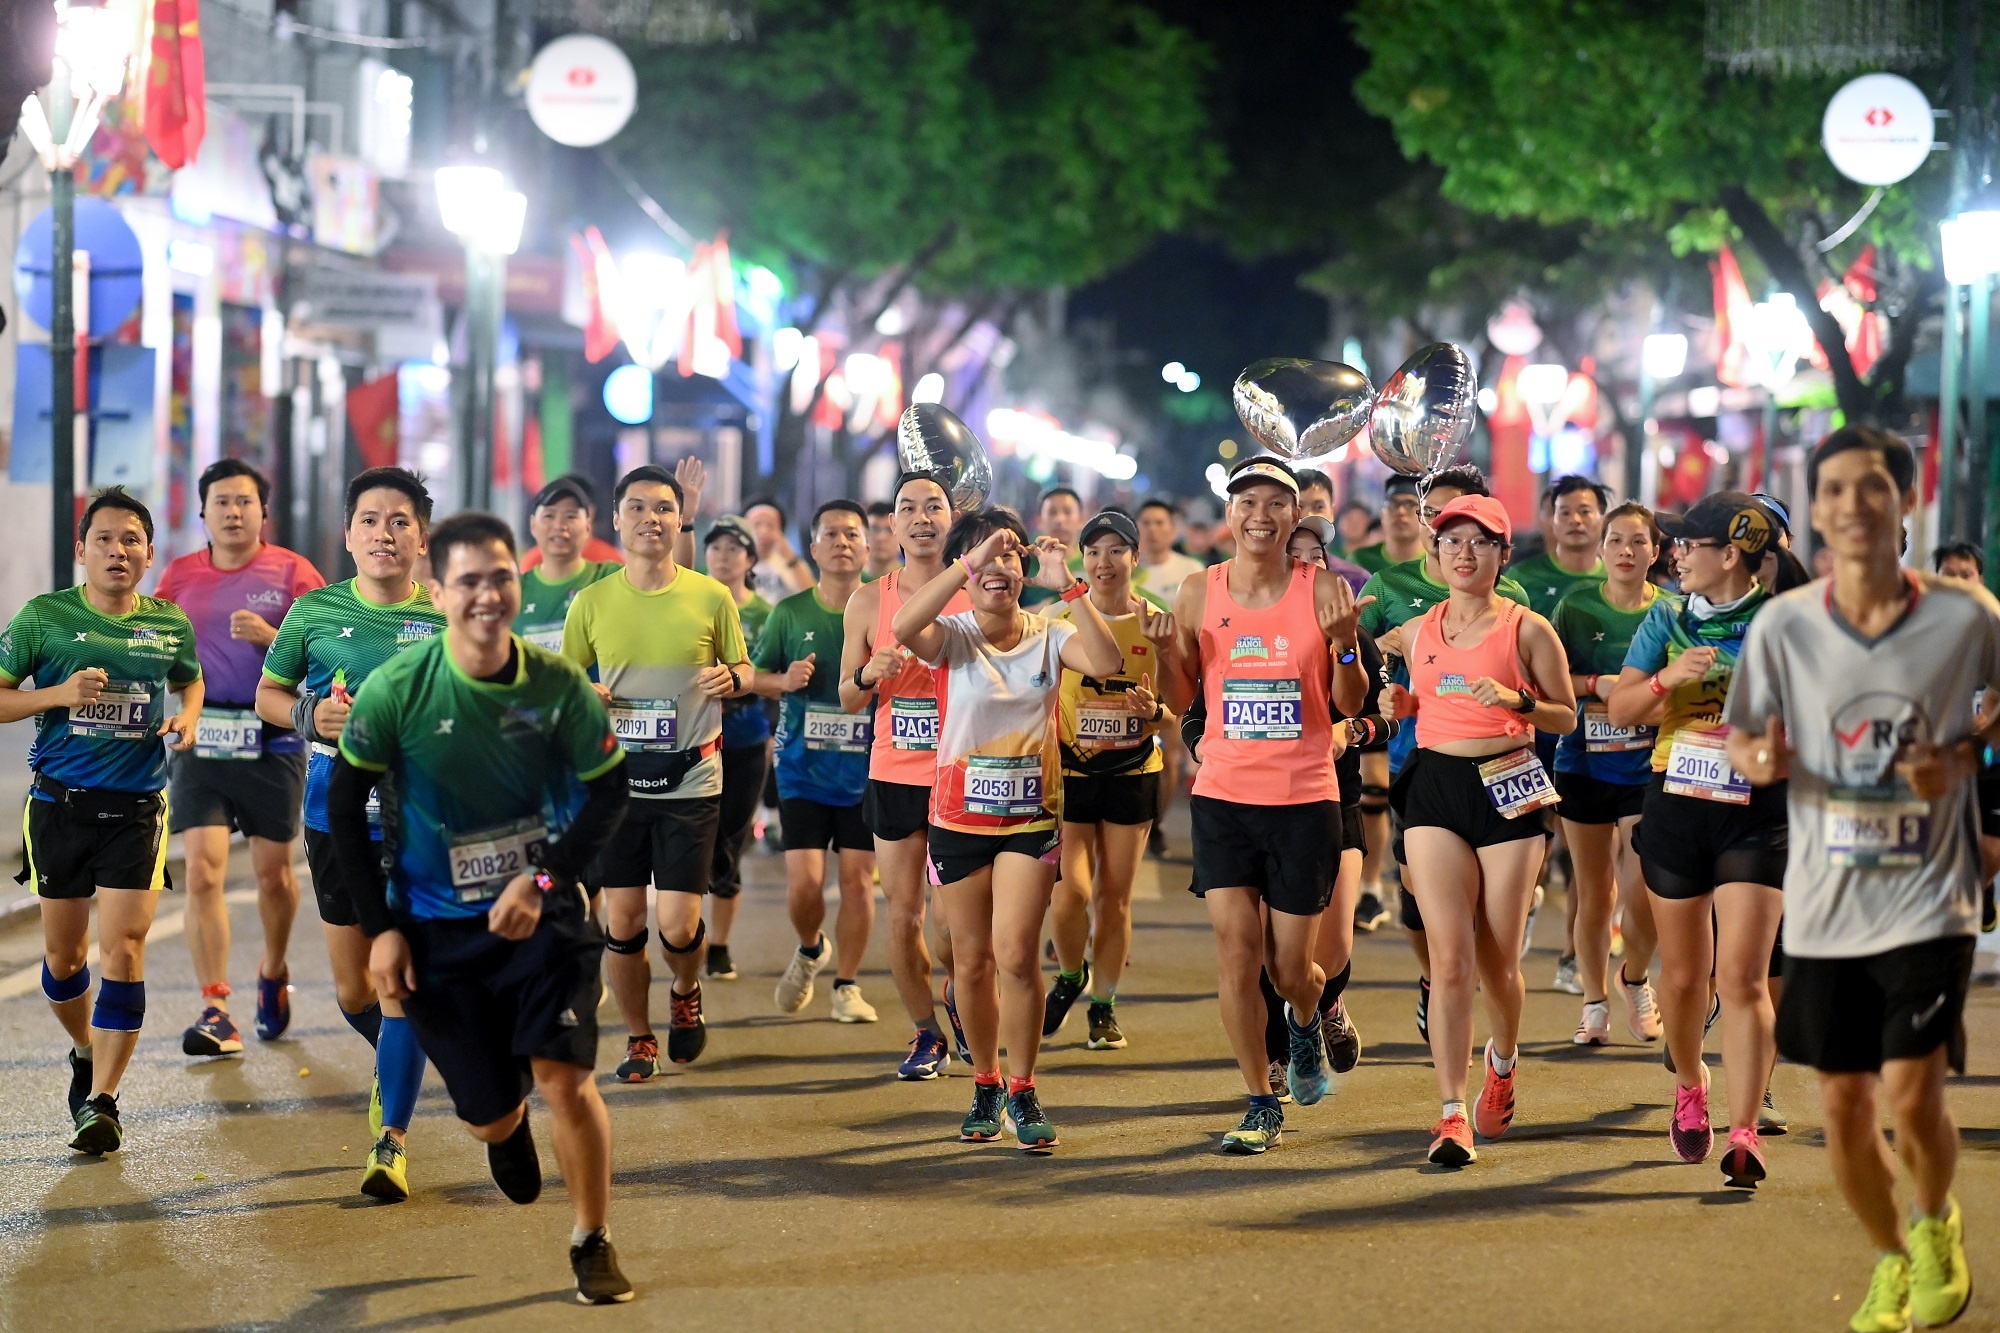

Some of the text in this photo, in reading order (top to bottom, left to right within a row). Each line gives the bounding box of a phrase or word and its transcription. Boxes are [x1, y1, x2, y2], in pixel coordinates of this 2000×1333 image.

[1732, 514, 1768, 550] Buff
[397, 633, 436, 643] MARATHO
[404, 626, 432, 635] HANOI
[128, 639, 164, 651] MARATHON
[1236, 640, 1262, 648] HANOI
[1230, 647, 1268, 660] MARATHON
[1441, 678, 1465, 686] HANOI
[76, 703, 143, 723] 20321 4
[1228, 702, 1295, 724] PACER
[616, 719, 670, 736] 20191 3
[810, 722, 864, 739] 21325 4
[895, 716, 939, 737] PACE
[1081, 718, 1138, 733] 20750 3
[199, 727, 256, 745] 20247 3
[1677, 756, 1719, 780] 20116
[628, 777, 668, 788] eebok
[972, 778, 1036, 797] 20531 2
[458, 850, 519, 879] 20822
